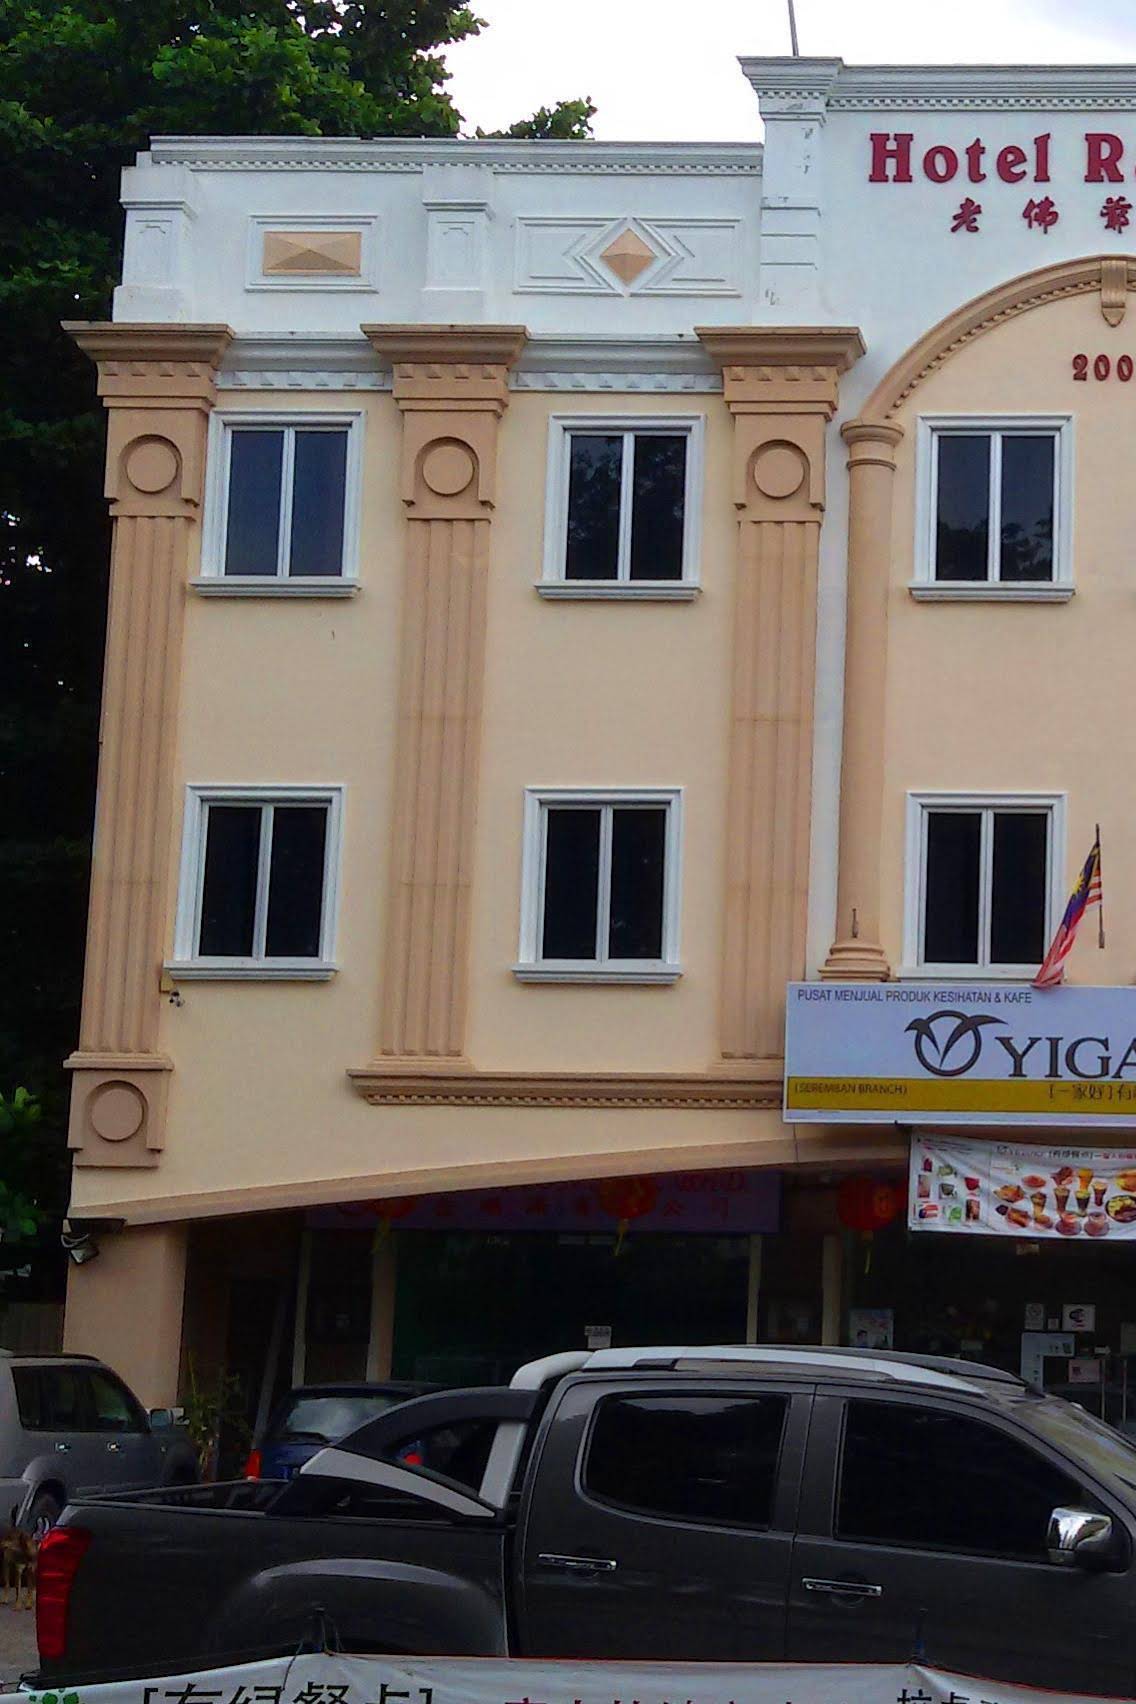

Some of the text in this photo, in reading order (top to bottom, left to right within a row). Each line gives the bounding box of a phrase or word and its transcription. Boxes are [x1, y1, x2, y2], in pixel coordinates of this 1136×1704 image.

[868, 132, 1053, 184] Hotel
[797, 988, 1032, 1004] PUSAT MENJUAL PRODUK KESIHATAN & KAFE
[794, 1081, 907, 1097] (SEREMBAN BRANCH)
